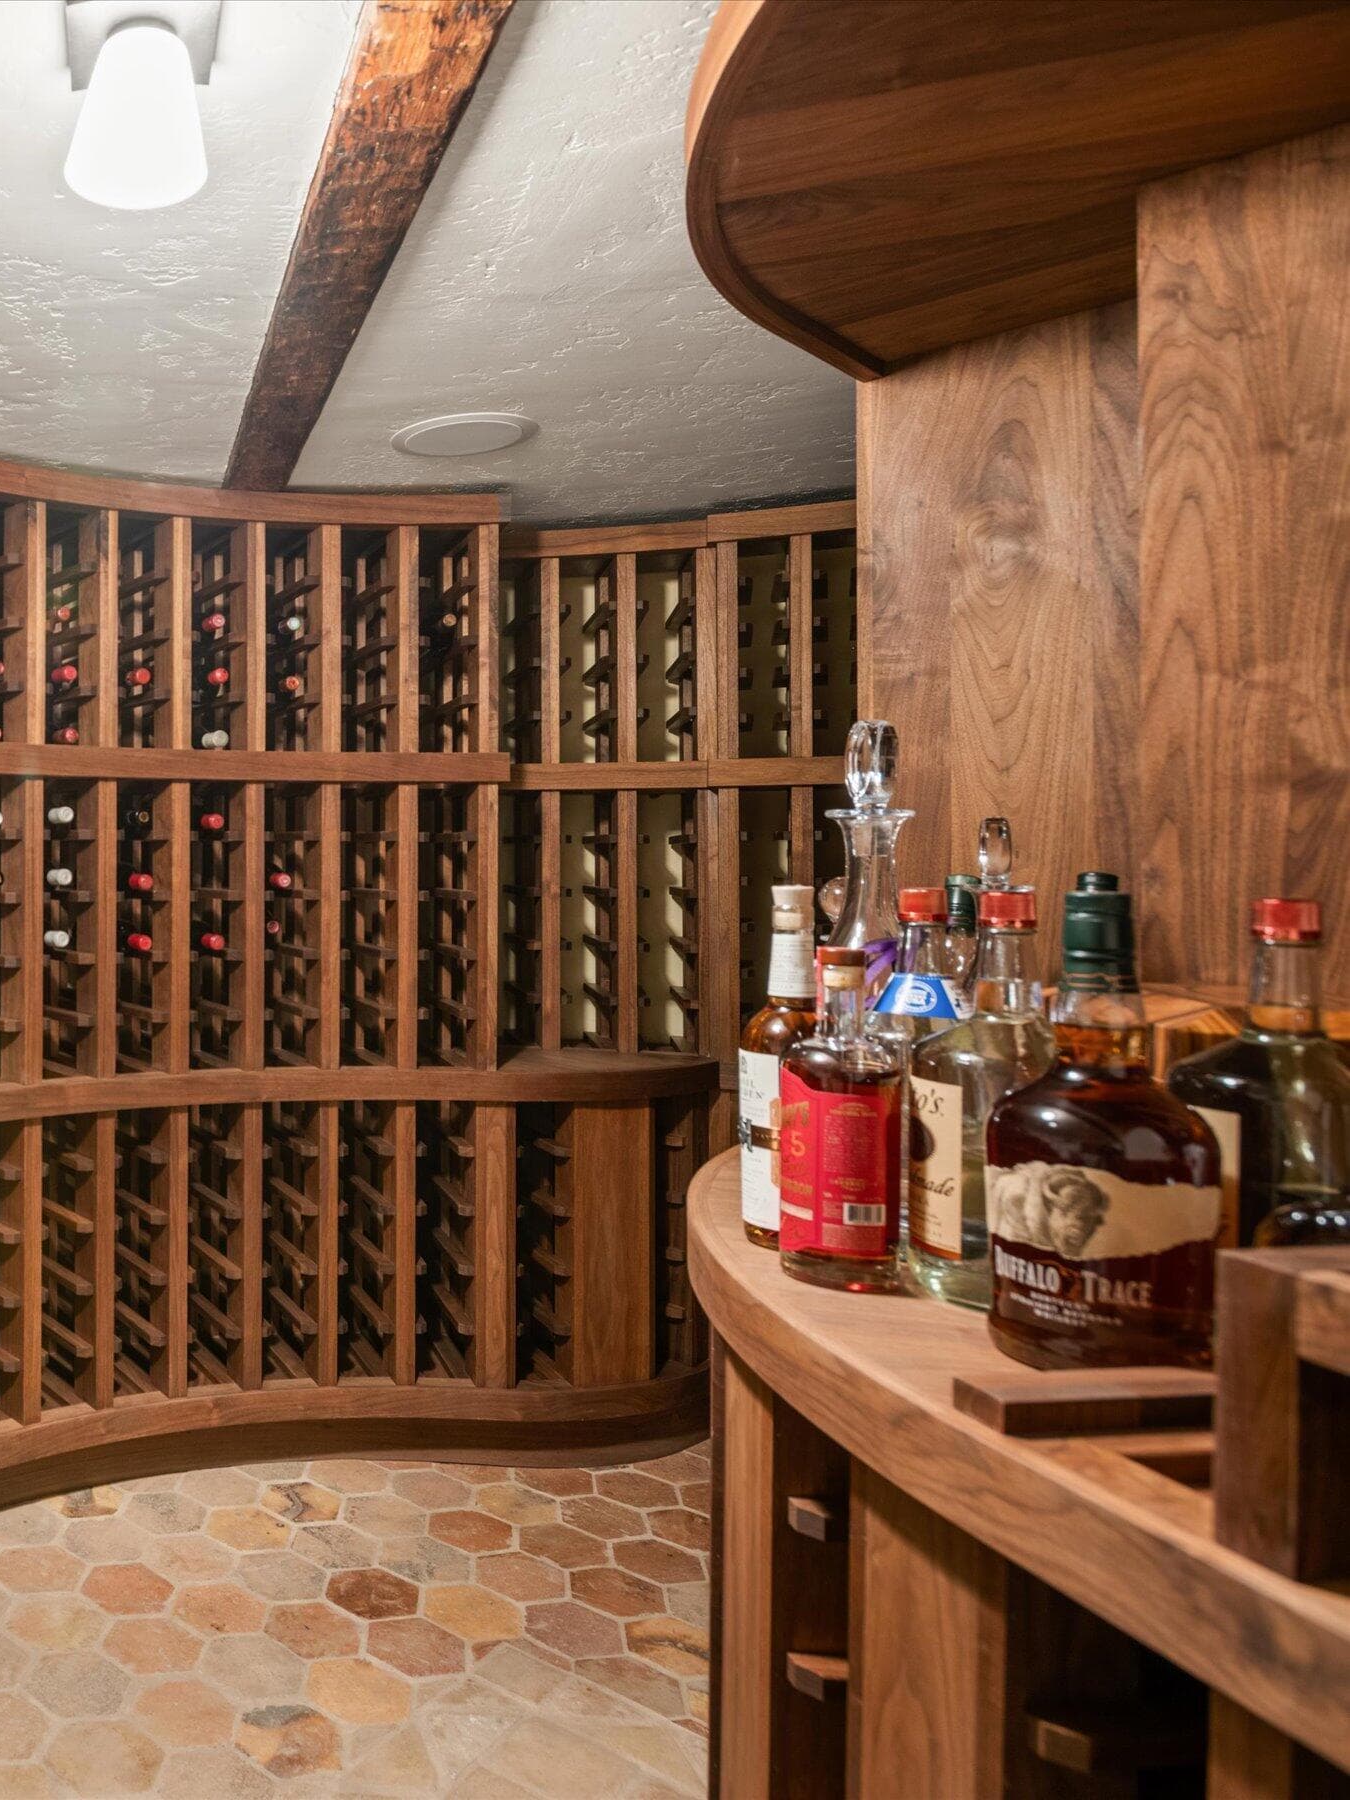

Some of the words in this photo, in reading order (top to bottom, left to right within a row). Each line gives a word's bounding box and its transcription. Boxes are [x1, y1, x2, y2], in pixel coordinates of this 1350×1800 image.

[791, 1130, 806, 1157] 5
[994, 1244, 1061, 1293] BUFFALO
[1081, 1270, 1152, 1307] TRACE
